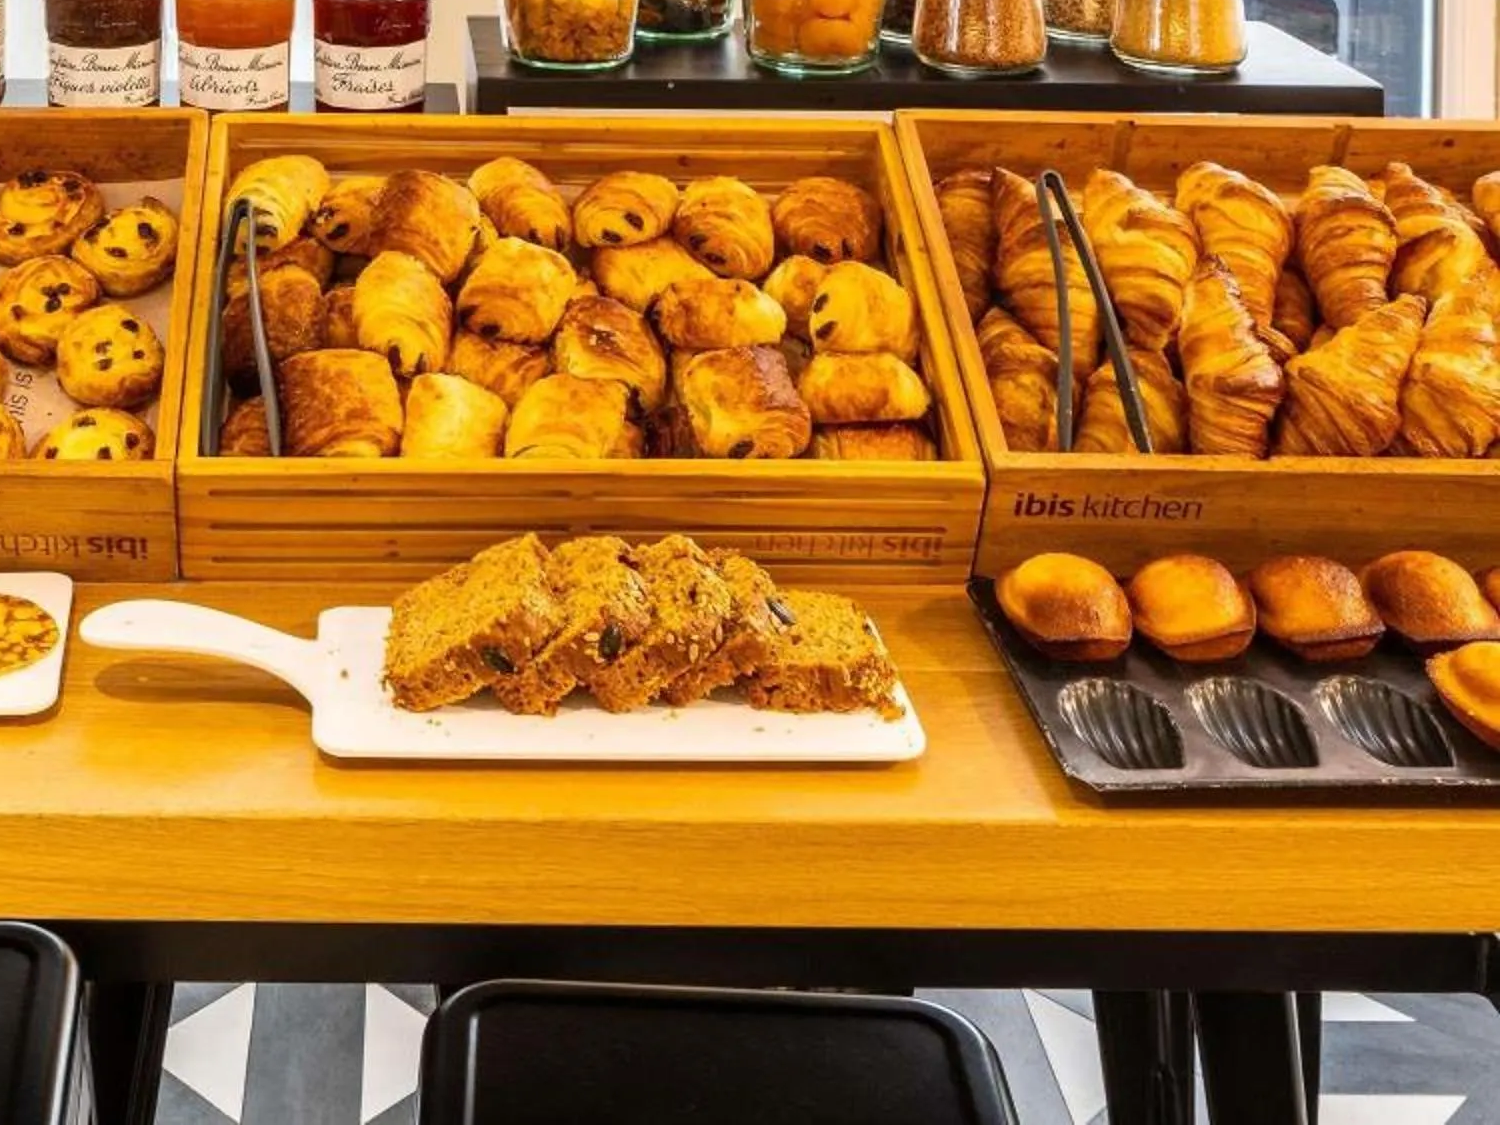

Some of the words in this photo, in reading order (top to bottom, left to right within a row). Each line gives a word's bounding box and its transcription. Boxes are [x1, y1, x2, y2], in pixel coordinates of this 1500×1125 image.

[1014, 492, 1076, 517] ibis
[1082, 493, 1204, 520] kitchen
[87, 535, 148, 560] ibis
[882, 536, 943, 559] ibis
